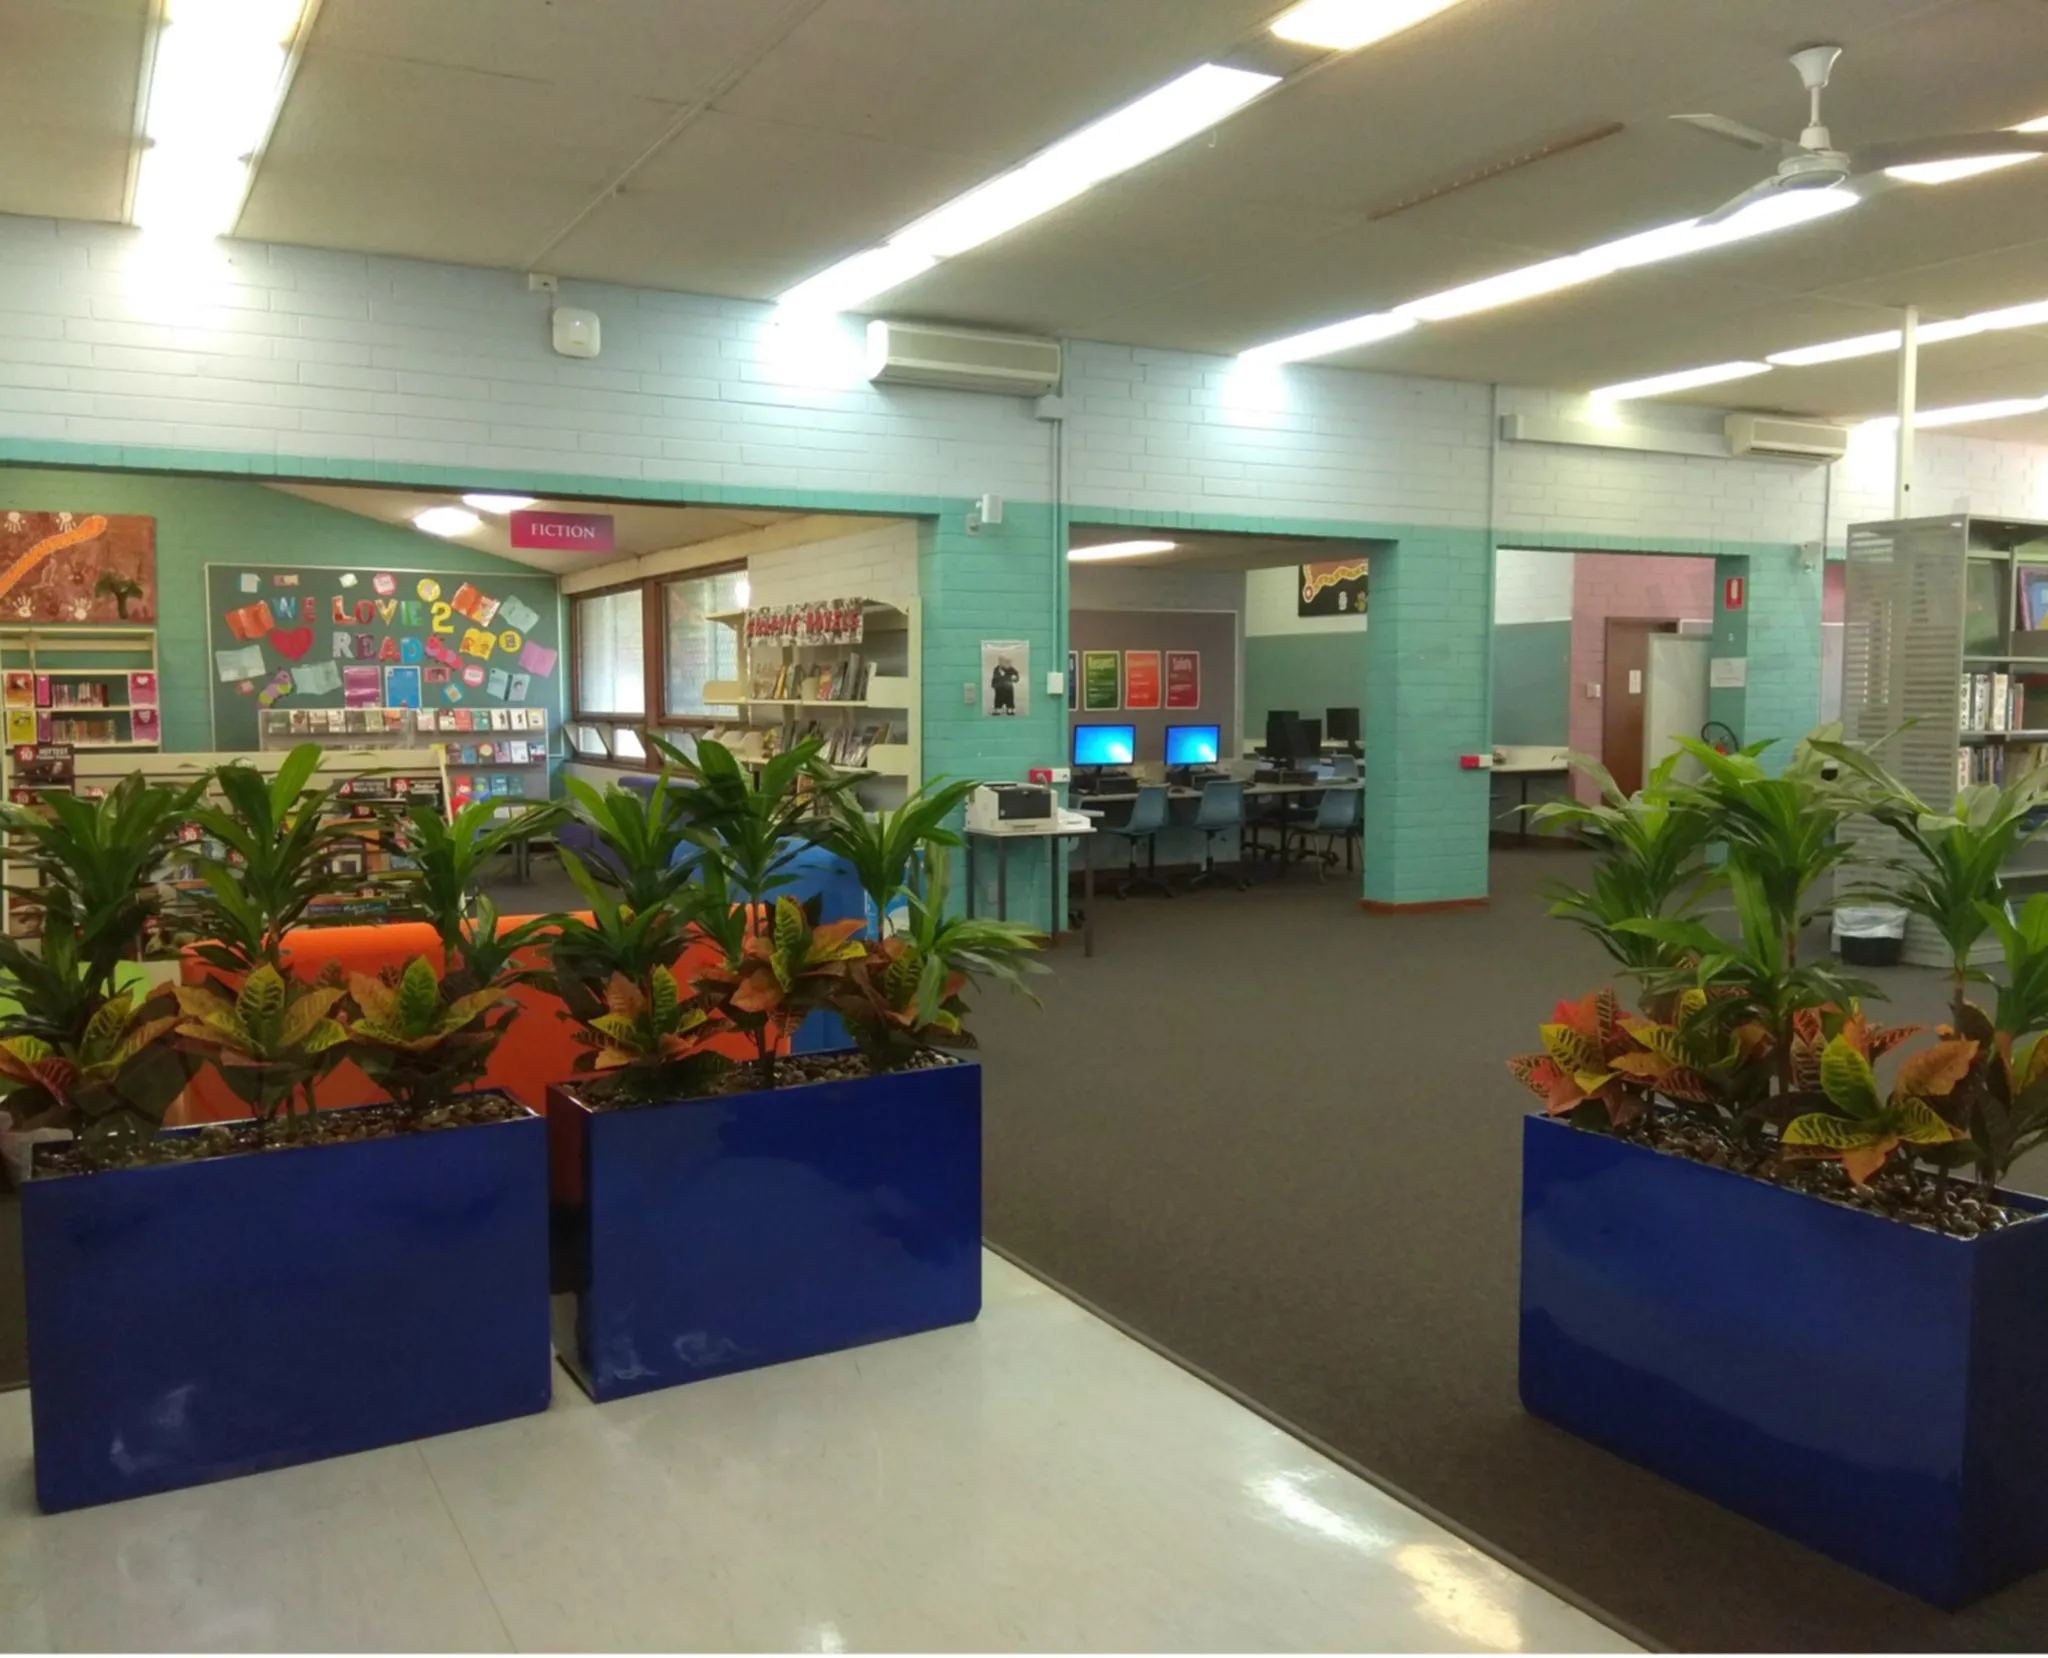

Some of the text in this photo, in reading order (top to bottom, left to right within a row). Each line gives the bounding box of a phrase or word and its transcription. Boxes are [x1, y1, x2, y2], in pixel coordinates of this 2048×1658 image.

[530, 523, 595, 539] FICTION
[271, 595, 454, 634] WE LOVE 2
[332, 631, 424, 664] READ
